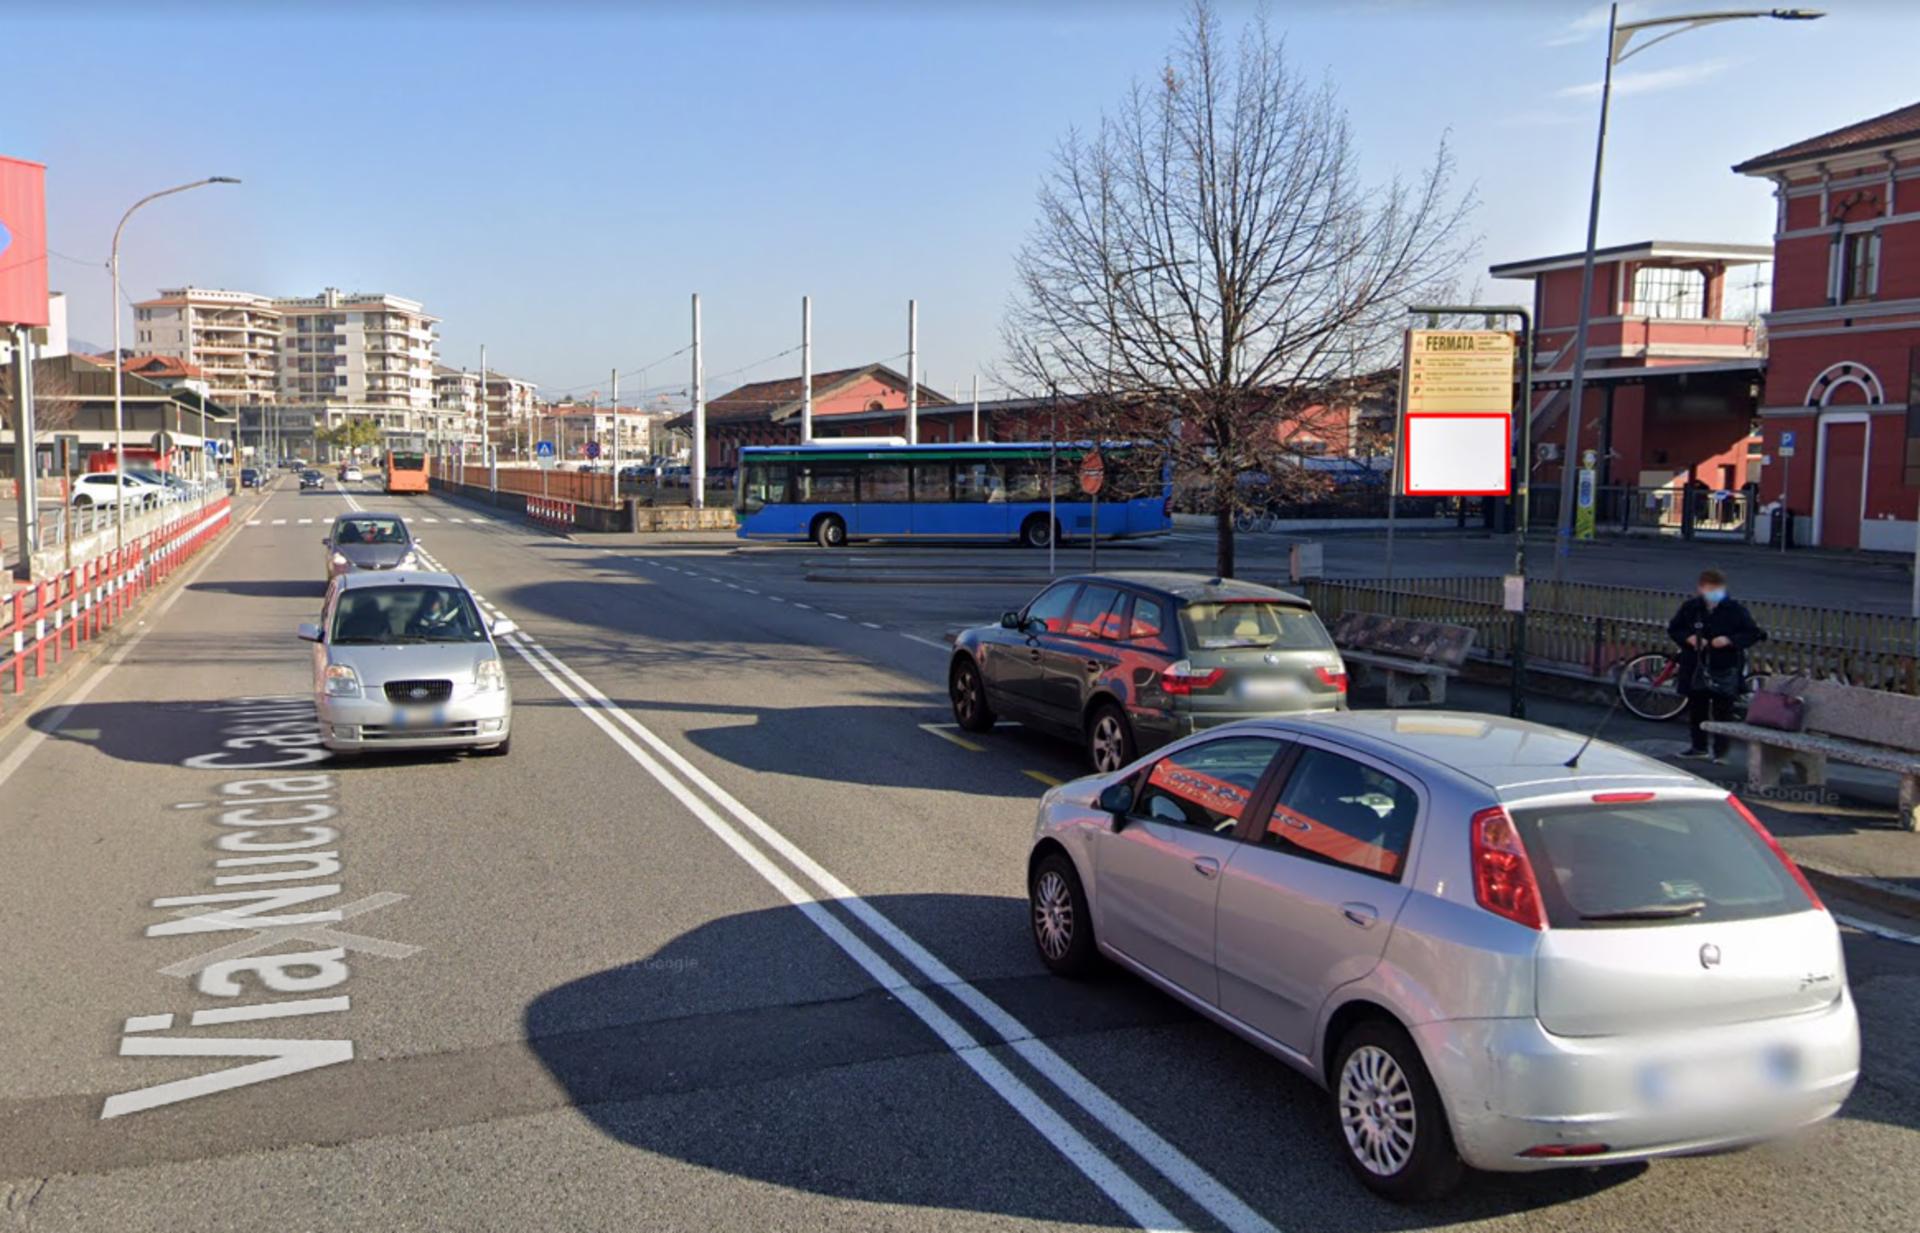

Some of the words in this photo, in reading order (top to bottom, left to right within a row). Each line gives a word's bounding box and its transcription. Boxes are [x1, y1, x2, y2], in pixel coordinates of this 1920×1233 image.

[1426, 335, 1475, 351] FERMATA
[1414, 358, 1422, 366] N
[1413, 386, 1421, 395] P
[1782, 433, 1792, 446] P
